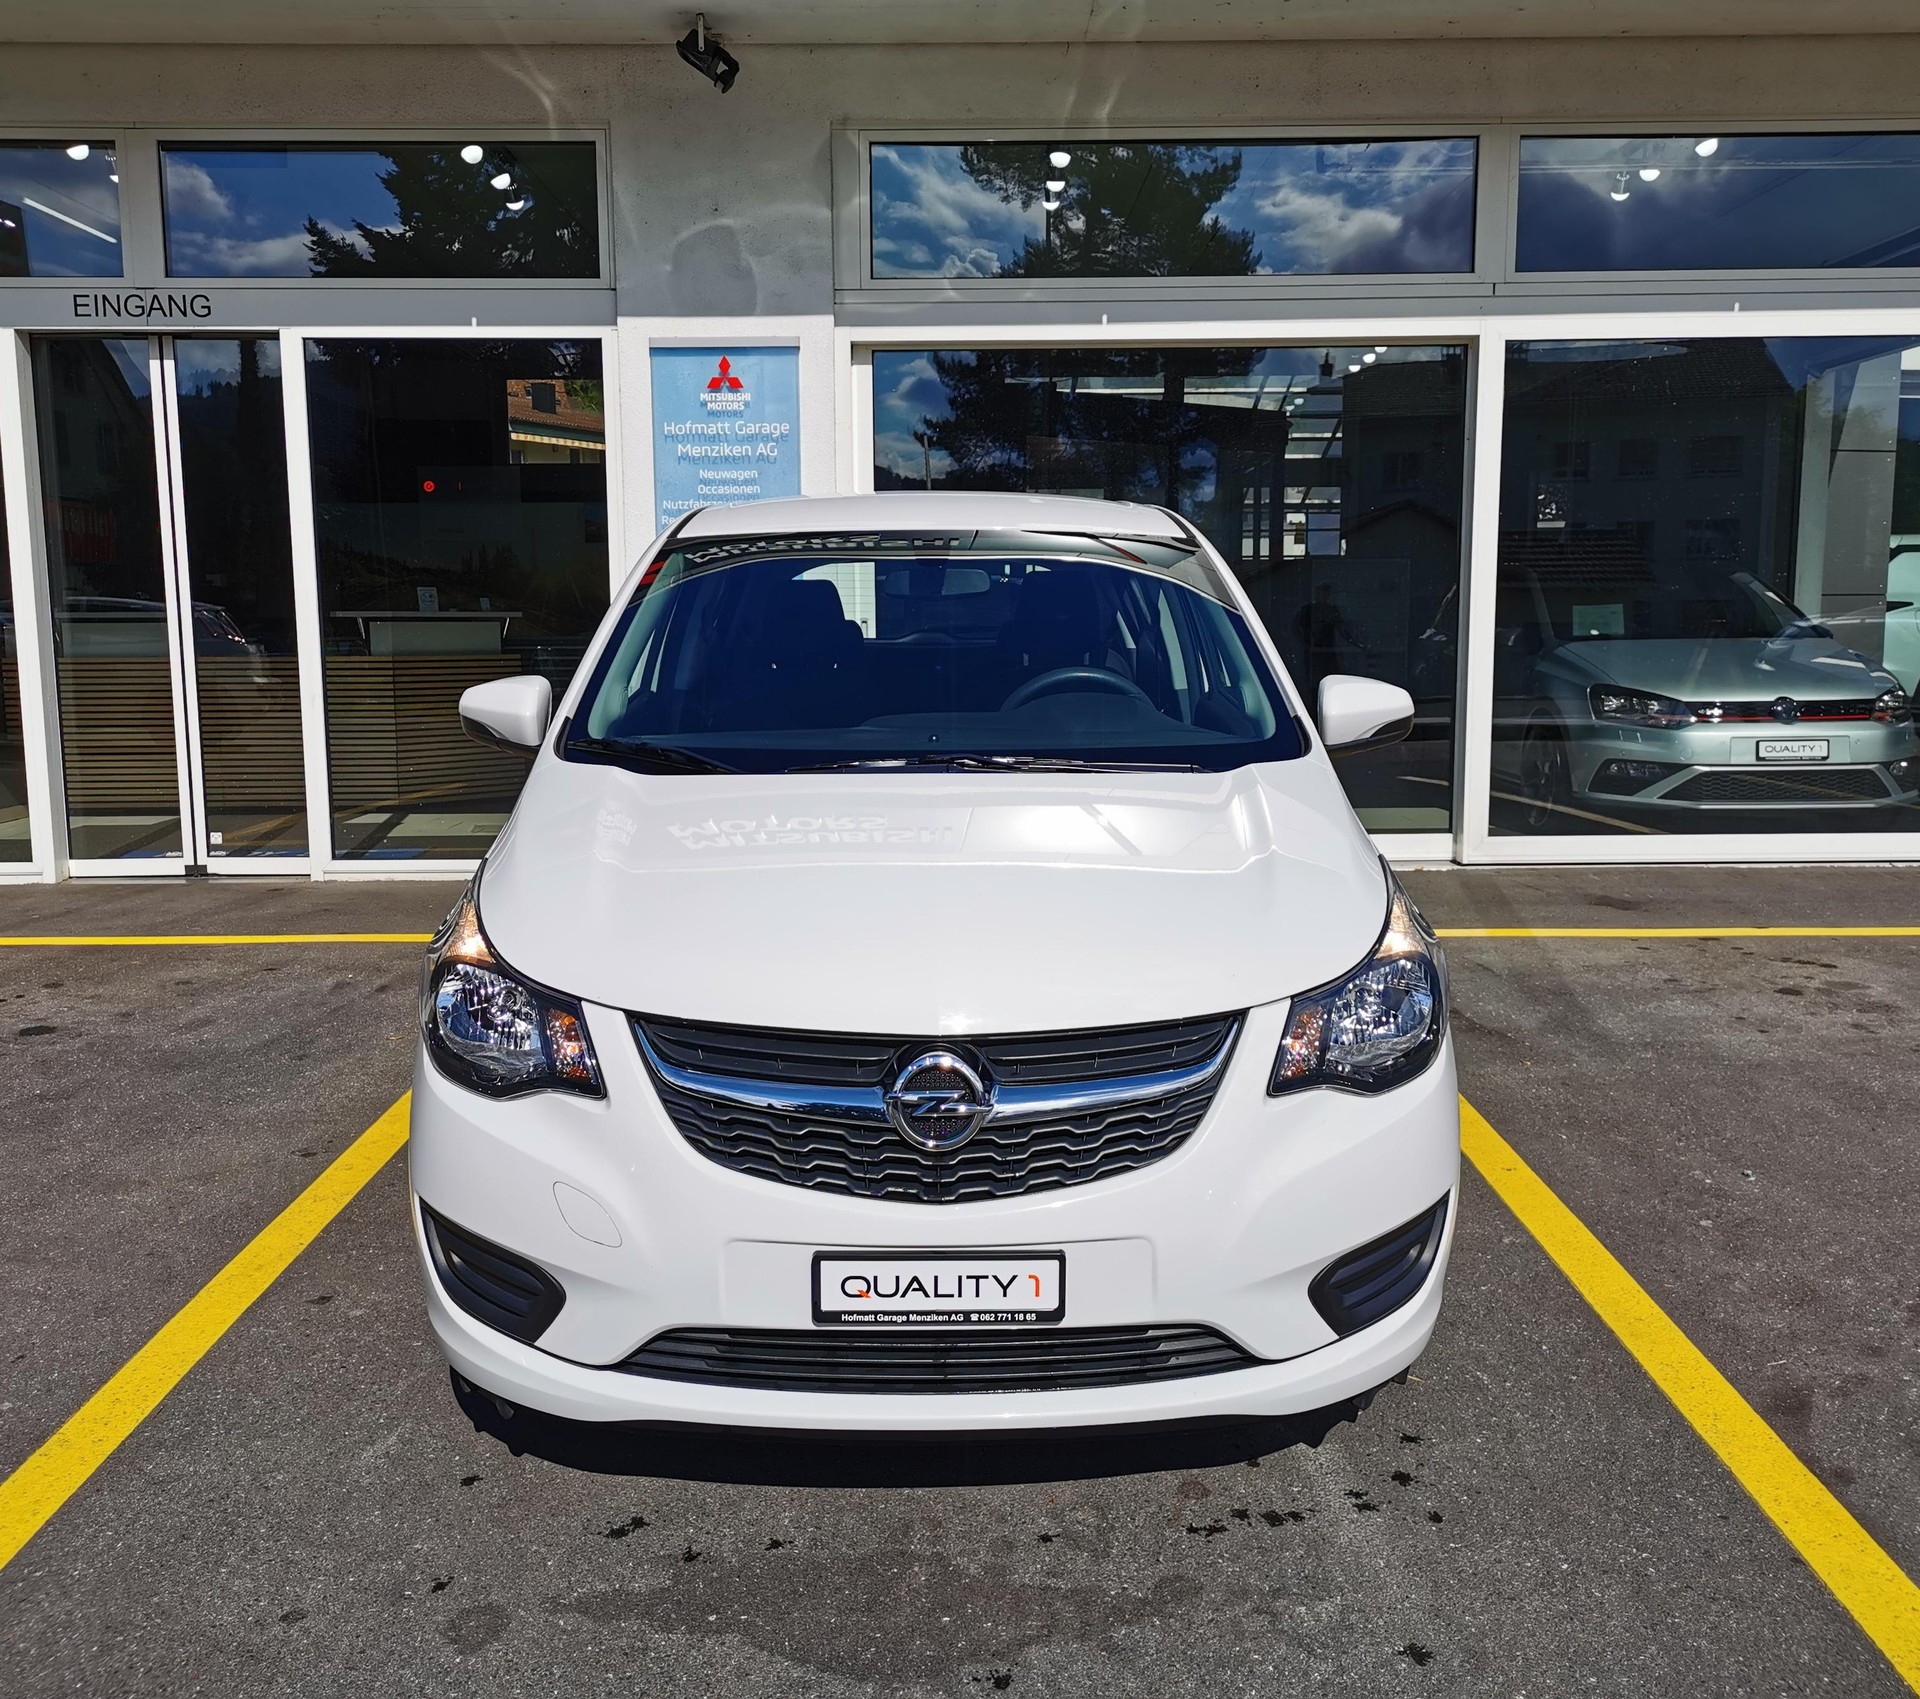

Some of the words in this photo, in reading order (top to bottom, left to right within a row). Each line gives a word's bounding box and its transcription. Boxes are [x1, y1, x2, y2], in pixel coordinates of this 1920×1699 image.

[73, 293, 212, 318] EINGANG
[700, 393, 751, 401] MITSUBISHI
[707, 402, 745, 411] MOTORS
[664, 421, 731, 435] Hofmatt
[735, 421, 790, 437] Garage
[677, 443, 751, 457] Menziken
[756, 443, 778, 456] AG
[699, 469, 758, 481] Neuwagen
[697, 484, 761, 495] Occasionen
[1764, 744, 1816, 753] QUALITY
[840, 1275, 1019, 1298] QUALITY
[1028, 1274, 1041, 1297] 1
[841, 1313, 875, 1322] Hofmatt
[876, 1313, 908, 1323] Garage
[909, 1313, 949, 1322] Menziken
[950, 1313, 964, 1322] AG
[980, 1313, 996, 1322] 062
[997, 1313, 1012, 1321] 771
[1014, 1313, 1025, 1321] 18
[1026, 1313, 1037, 1321] 65
